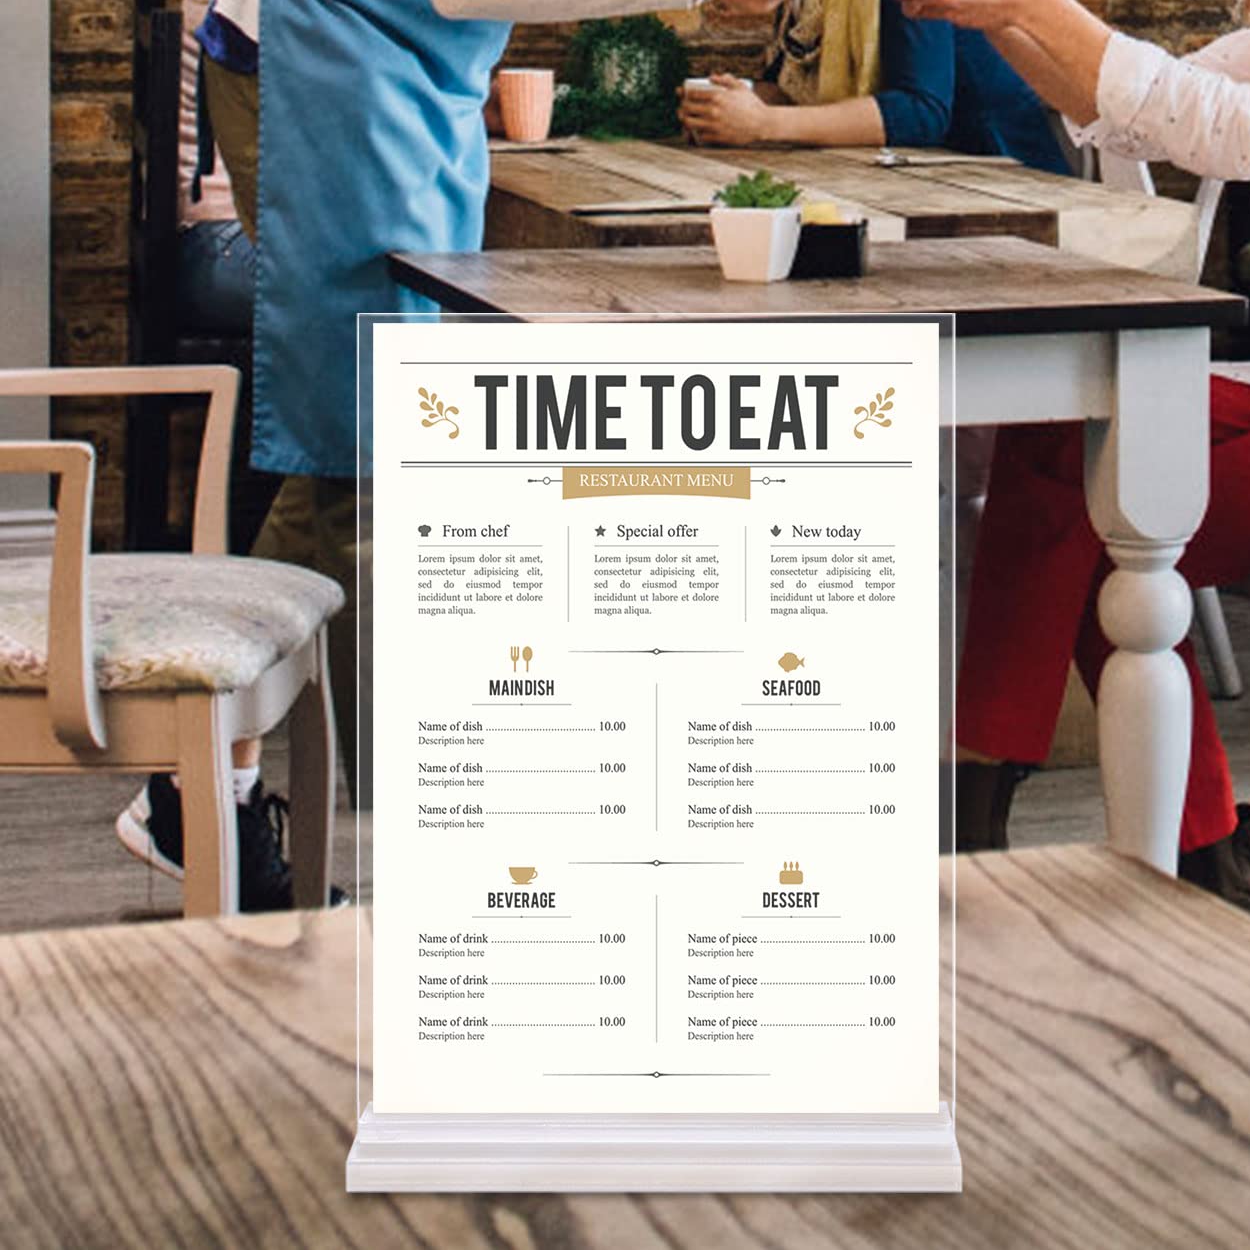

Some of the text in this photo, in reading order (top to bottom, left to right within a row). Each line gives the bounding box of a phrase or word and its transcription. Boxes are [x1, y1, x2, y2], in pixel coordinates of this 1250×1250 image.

[475, 375, 838, 450] TIME TO EAT
[580, 474, 733, 486] RESTAURANT MENU
[443, 524, 510, 537] From chef
[617, 524, 699, 540] Special offer
[792, 525, 861, 541] New today
[450, 554, 475, 564] ipsum
[479, 554, 501, 562] dolor
[626, 554, 651, 564] ipsum
[655, 554, 677, 562] dolor
[771, 555, 797, 563] Lorem
[802, 554, 827, 564] ipsum
[831, 554, 854, 562] dolor
[474, 567, 519, 577] adipisicing
[527, 567, 543, 576] elit,
[650, 567, 695, 577] adipisicing
[703, 567, 719, 576] elit,
[826, 567, 871, 577] adipisicing
[879, 567, 895, 576] elit,
[418, 580, 543, 590] sed do eiusmod tempor
[594, 580, 719, 590] sed do eiusmod tempor
[770, 580, 895, 590] sed do eiusmod tempor
[418, 593, 460, 601] incididunt
[476, 593, 502, 601] labore
[516, 593, 543, 601] dolore
[595, 593, 636, 601] incididunt
[652, 593, 678, 601] labore
[692, 593, 719, 601] dolore
[771, 593, 812, 601] incididunt
[828, 593, 854, 601] labore
[869, 593, 895, 601] dolore
[418, 606, 475, 616] magna aliqua.
[595, 606, 651, 616] magna aliqua.
[771, 606, 827, 616] magna aliqua.
[762, 680, 820, 696] SEAFOOD
[418, 721, 626, 731] Name of dish 10.00
[688, 721, 895, 731] Name of dish 10.00
[419, 736, 484, 746] Description here
[688, 736, 754, 747] Description here
[419, 763, 626, 773] Name of dish 10.00
[688, 763, 895, 773] Name of dish 10.00
[419, 778, 484, 788] Description here
[688, 778, 754, 788] Description here
[418, 804, 626, 814] Name of dish 10.00
[688, 804, 895, 814] Name of dish 10.00
[419, 820, 484, 830] Description here
[688, 819, 754, 830] Description here
[488, 892, 555, 908] BEVERAGE
[763, 892, 820, 908] DESSERT
[419, 933, 625, 943] Name of drink 10.00
[688, 933, 895, 946] Name of piece 10.00
[419, 948, 484, 959] Description here
[688, 949, 754, 958] Description here
[419, 975, 625, 985] Name of drink 10.00
[688, 975, 895, 987] Name of piece 10.00
[419, 990, 484, 1000] Description here
[688, 990, 754, 1000] Description here
[419, 1017, 625, 1026] Name of drink 10.00
[688, 1017, 895, 1029] Name of piece 10.00
[419, 1032, 484, 1042] Description here
[688, 1032, 754, 1042] Description here
